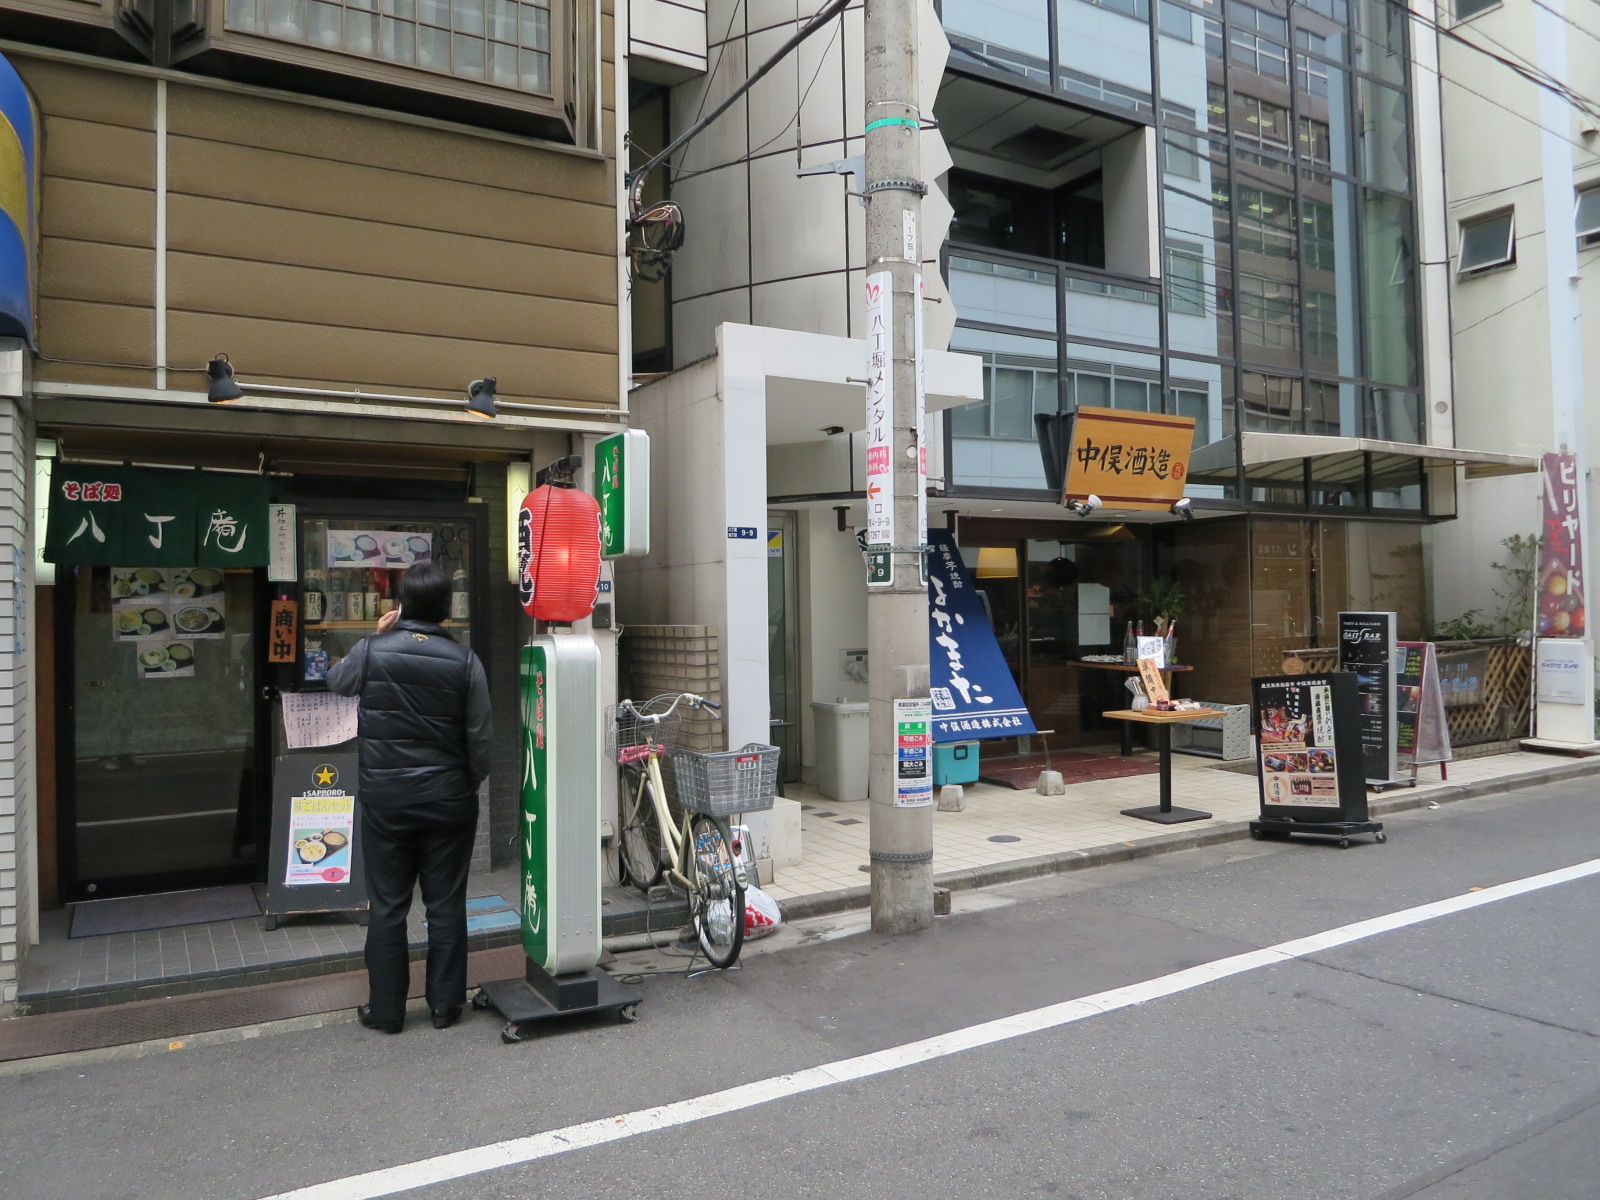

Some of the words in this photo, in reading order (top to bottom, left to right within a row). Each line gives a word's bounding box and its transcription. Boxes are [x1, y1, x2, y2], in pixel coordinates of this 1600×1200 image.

[871, 315, 886, 442] 八丁堀メンタル
[1077, 438, 1171, 480] 中俣酒造
[63, 482, 122, 501] そば処
[67, 508, 247, 553] 八丁庵
[743, 530, 757, 538] 9-9
[1560, 461, 1581, 595] ビリヤード
[274, 609, 293, 659] 商い中
[939, 716, 1022, 733] 中俣酒造株式会社
[294, 799, 352, 813] 味ごはんセット
[306, 788, 343, 797] SAPPORO
[523, 730, 541, 934] 八丁庵
